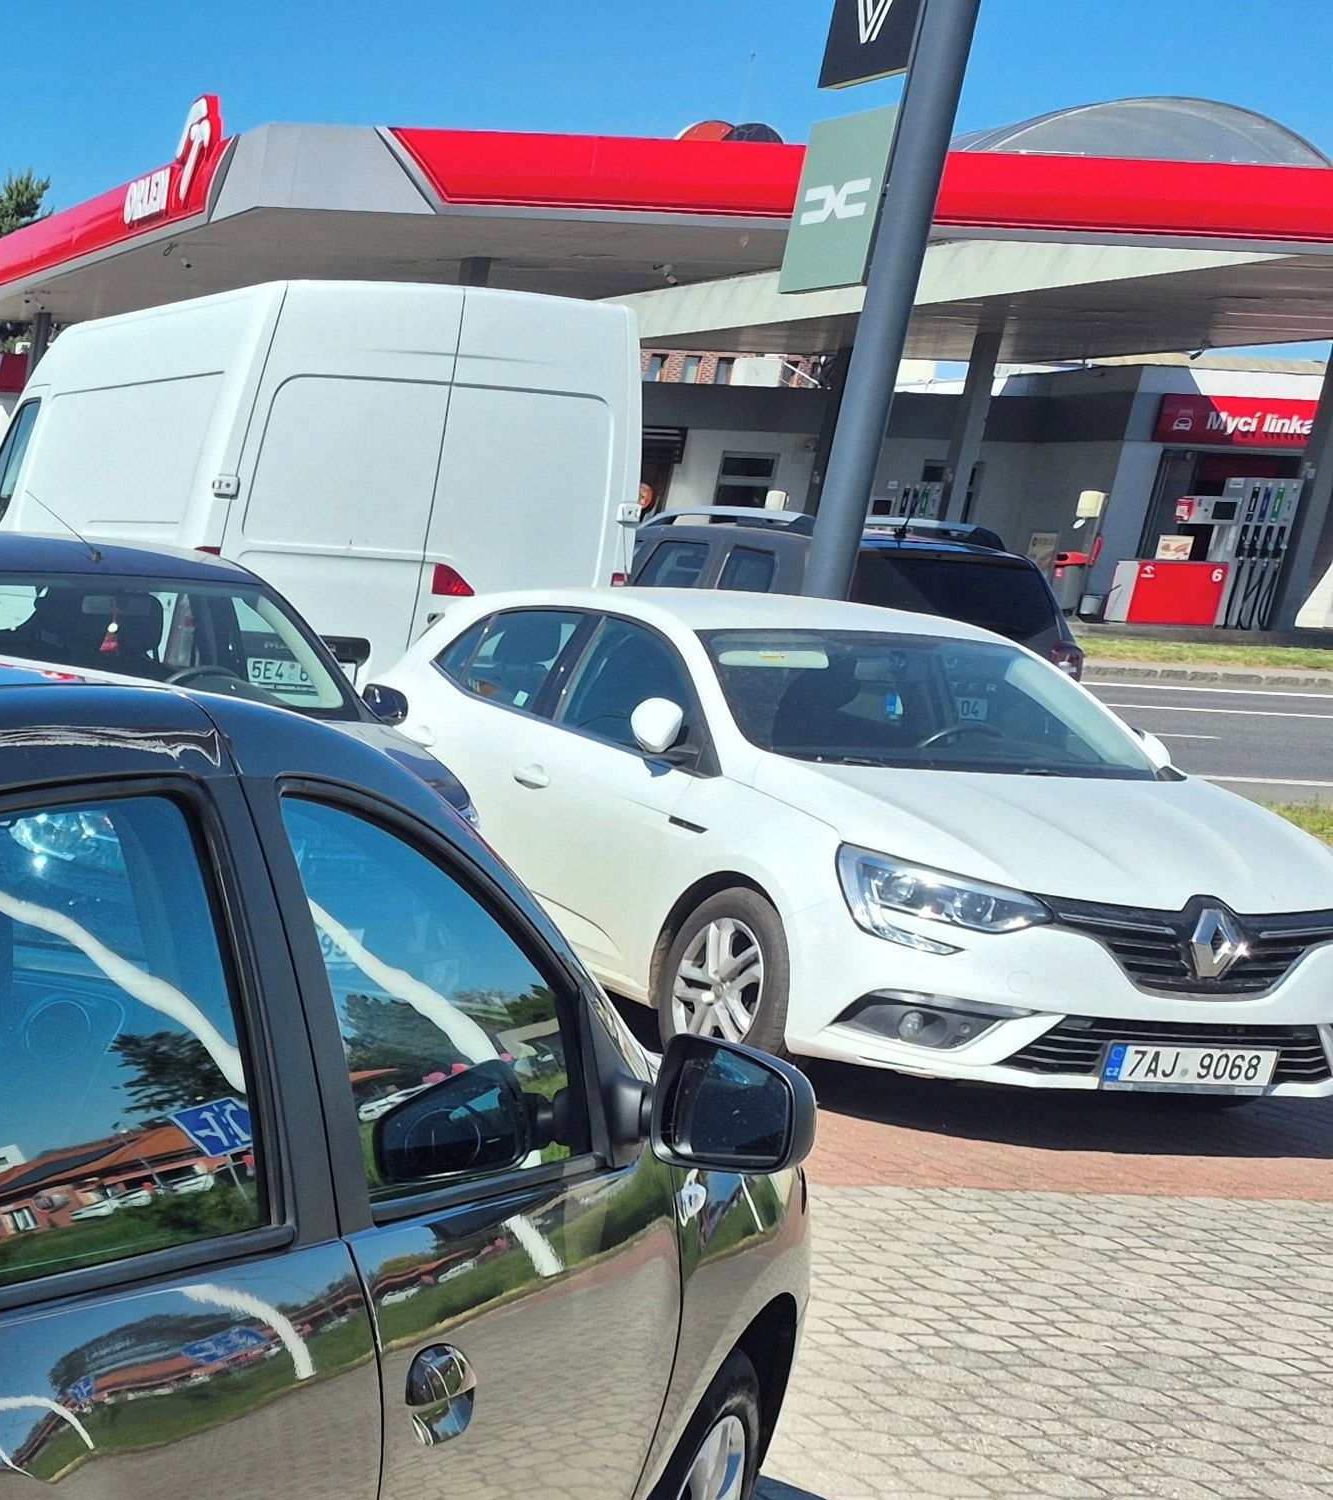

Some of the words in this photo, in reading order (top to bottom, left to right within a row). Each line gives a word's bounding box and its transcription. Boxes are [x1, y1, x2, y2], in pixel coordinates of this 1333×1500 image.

[1206, 411, 1260, 436] Mycí
[1211, 568, 1225, 583] 6
[251, 660, 284, 680] 5E4
[1128, 1050, 1181, 1078] 7AJ
[1196, 1053, 1261, 1080] 9068
